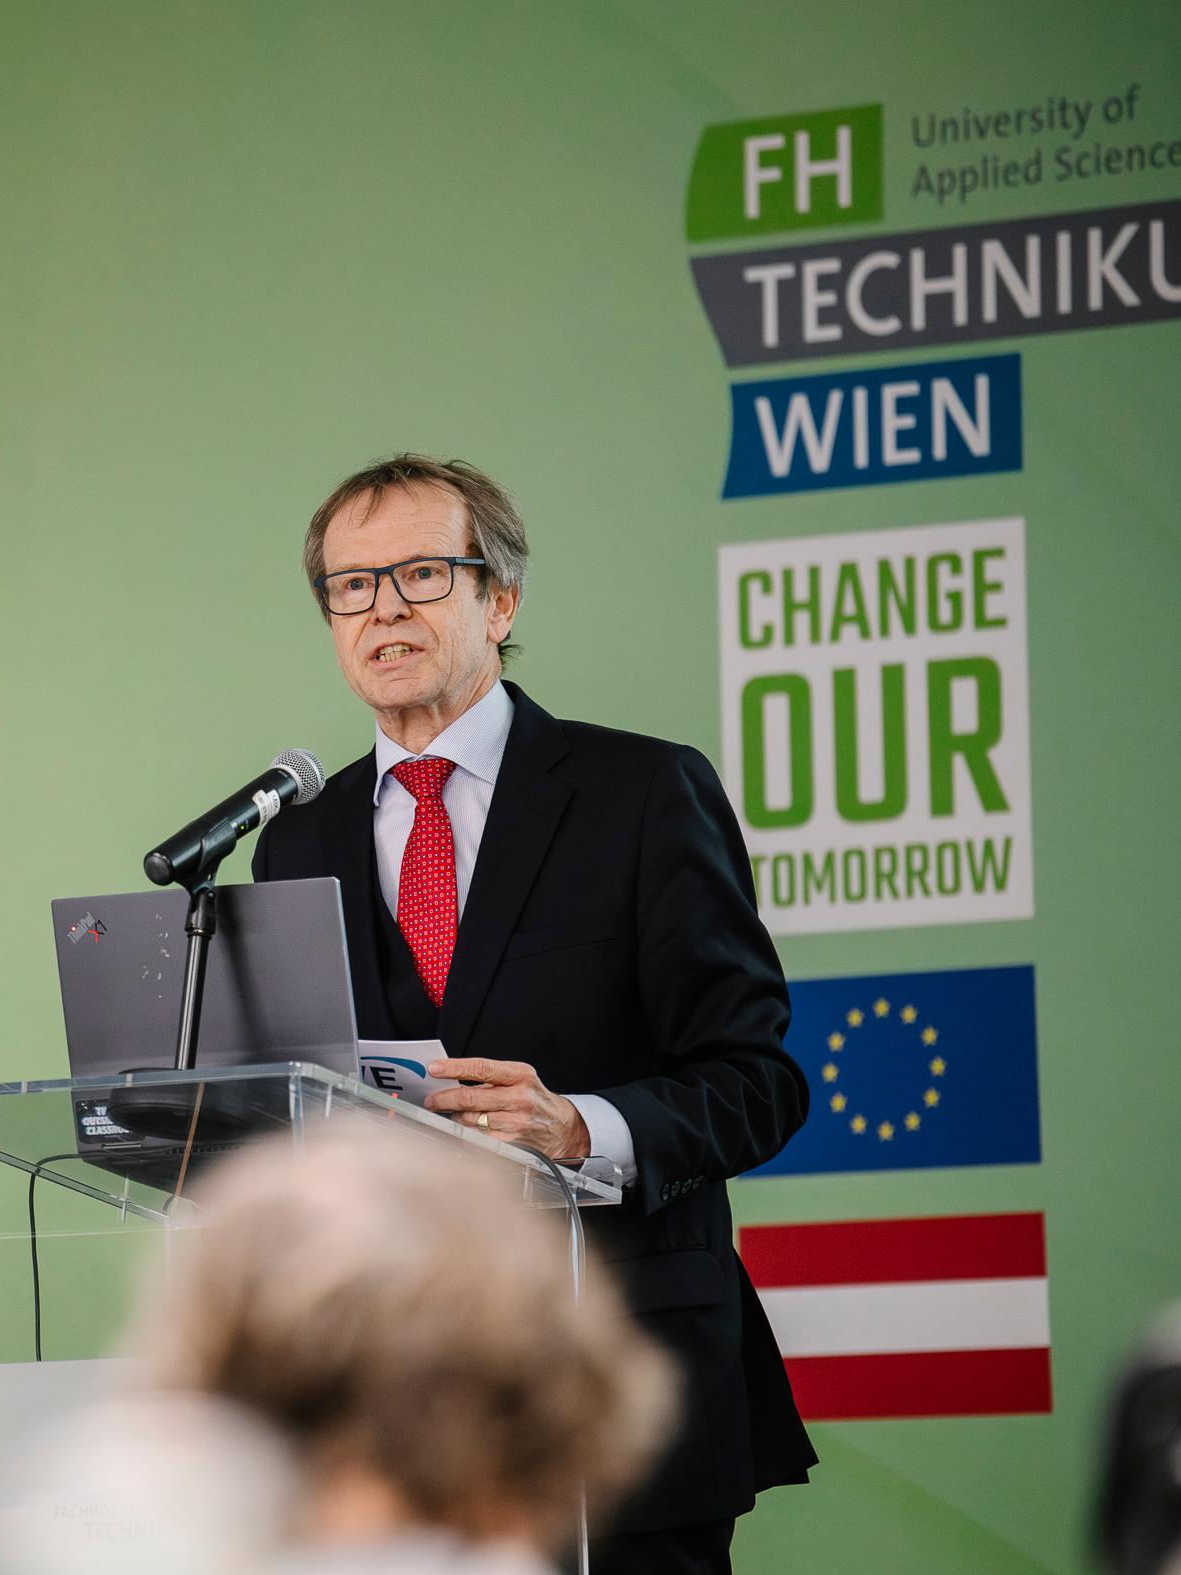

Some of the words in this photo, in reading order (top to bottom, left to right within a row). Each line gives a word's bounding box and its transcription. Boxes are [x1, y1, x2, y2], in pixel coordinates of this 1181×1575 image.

[912, 97, 1093, 148] University
[1102, 83, 1141, 124] of
[743, 124, 852, 220] FH
[911, 146, 1043, 206] Applied
[754, 373, 991, 479] WIEN
[736, 545, 1009, 651] CHANGE
[740, 654, 1012, 832] OUR
[750, 835, 1013, 910] TOMORROW
